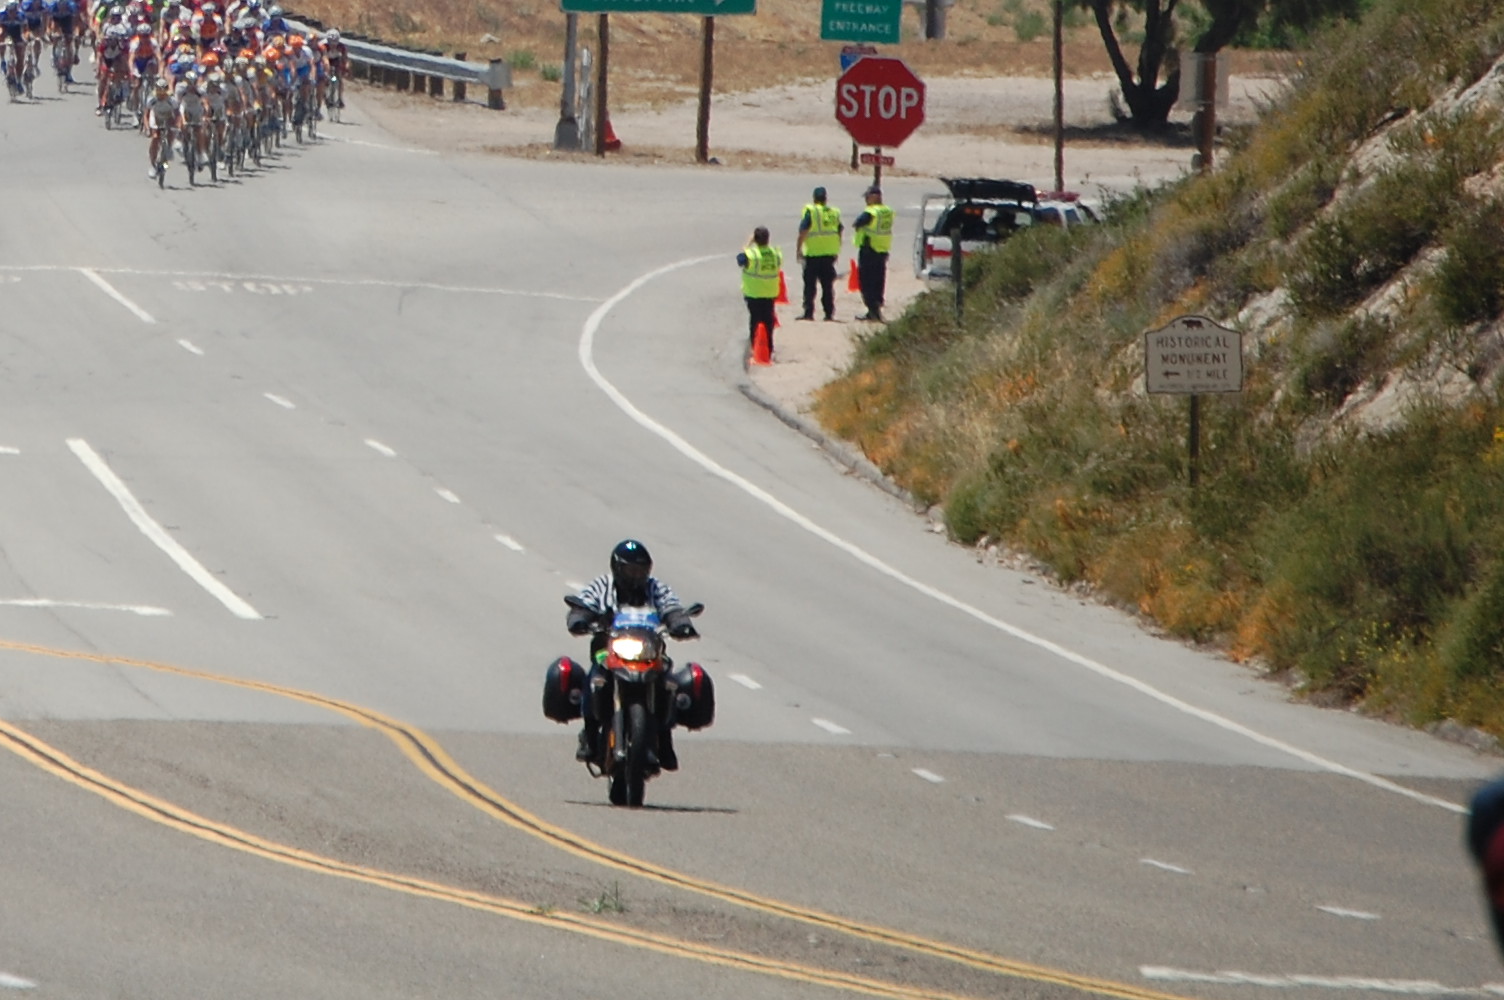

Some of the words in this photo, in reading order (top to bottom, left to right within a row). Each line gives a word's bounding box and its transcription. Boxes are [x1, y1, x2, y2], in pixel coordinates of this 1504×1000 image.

[834, 1, 889, 15] FREEWAY
[828, 20, 892, 34] ENTRANCE
[839, 83, 920, 119] STOP
[171, 280, 314, 295] STOP
[1156, 335, 1231, 349] HISTORICAL
[1160, 352, 1228, 365] MONUMENT
[1206, 369, 1229, 380] MILE
